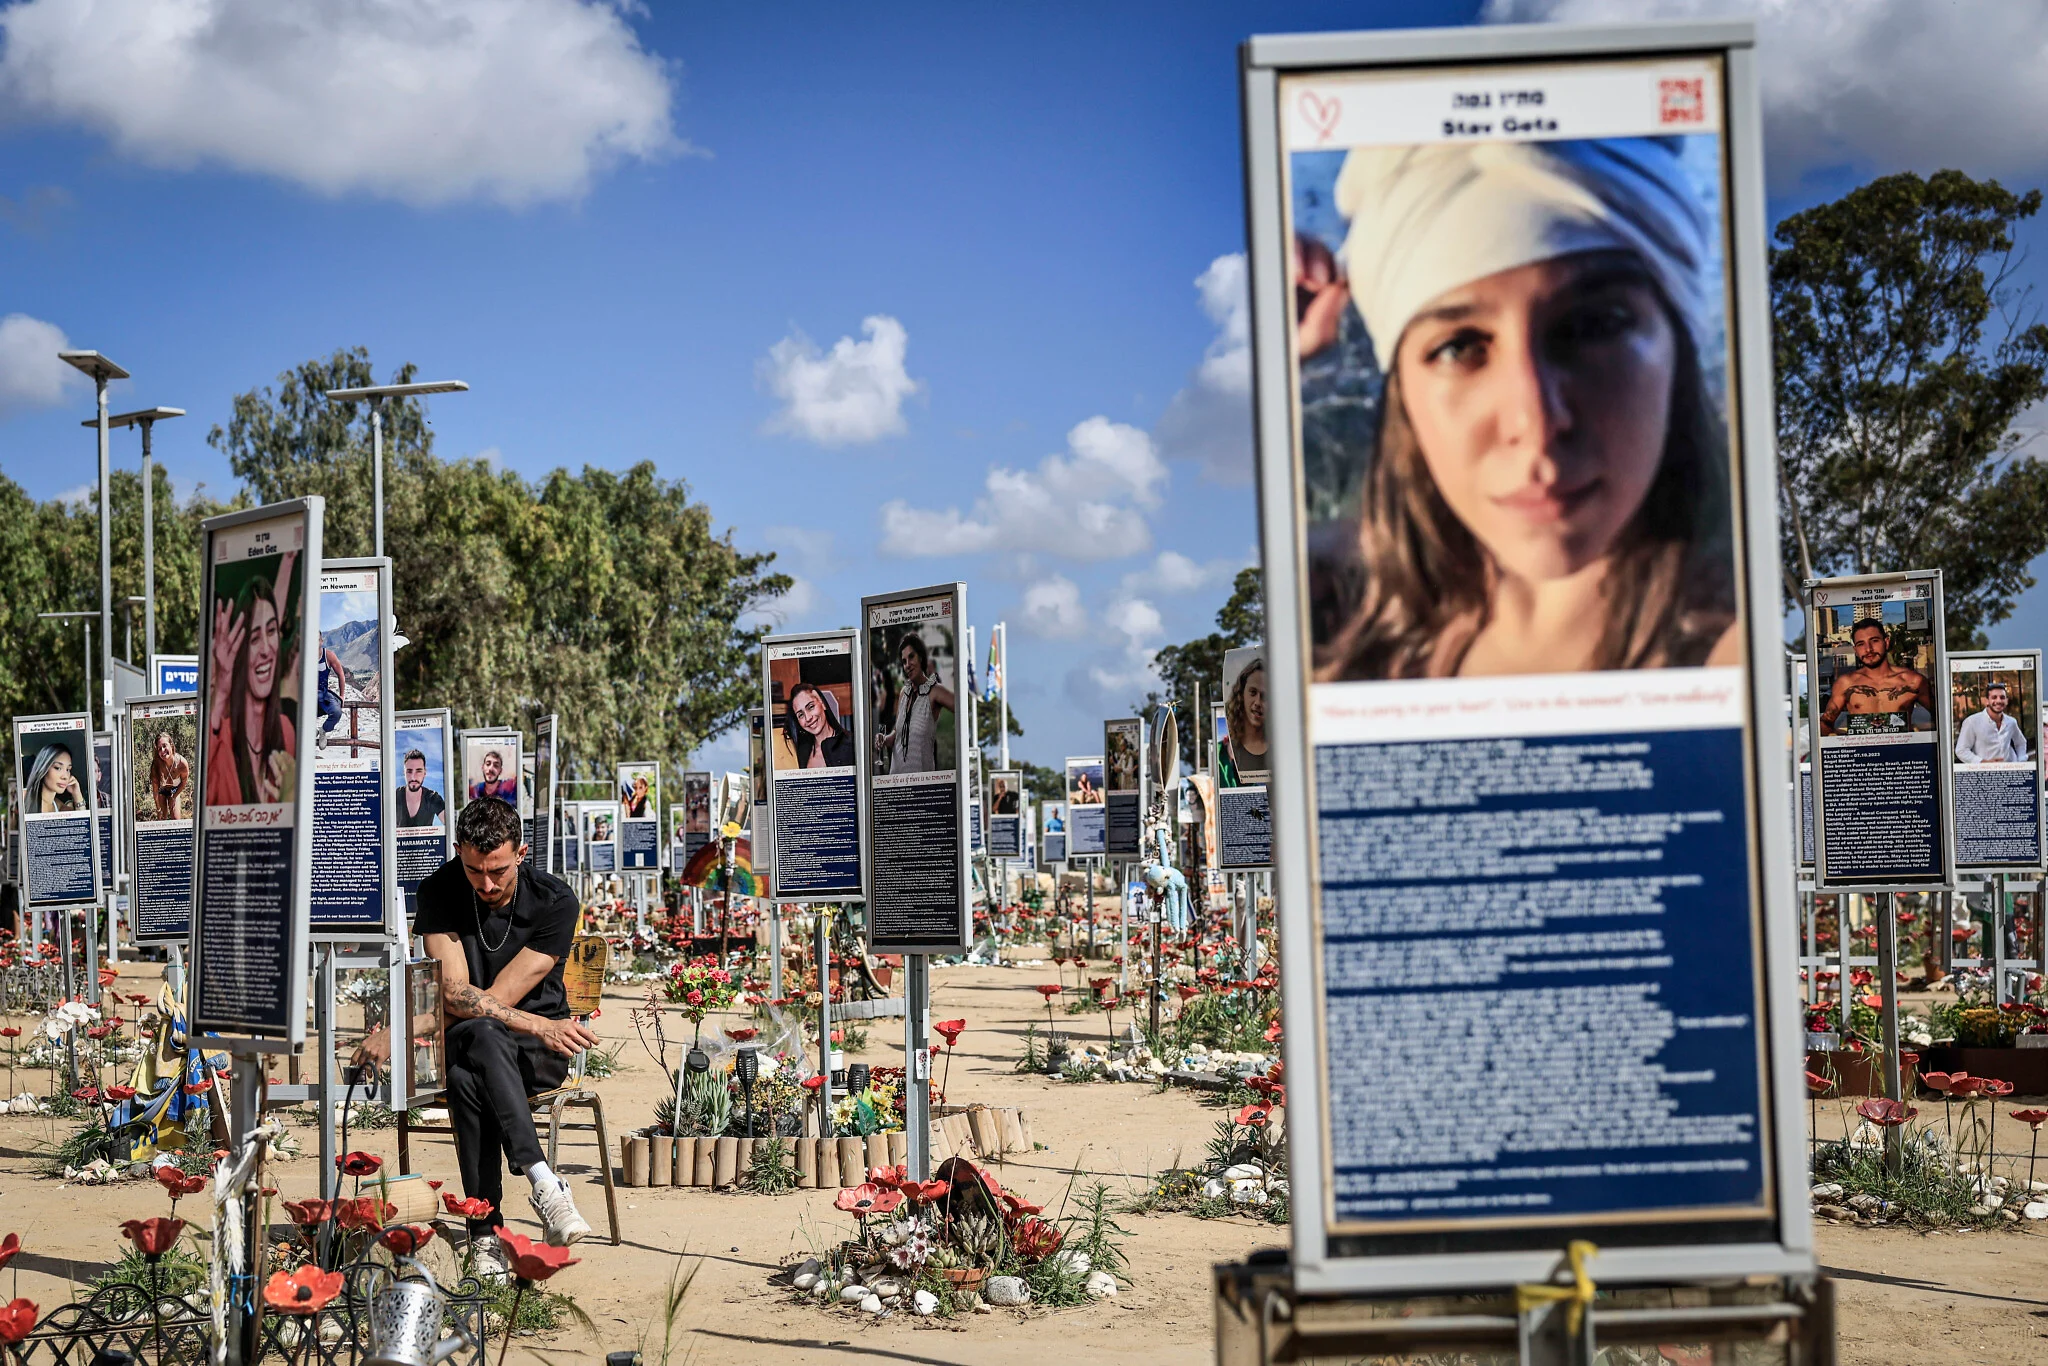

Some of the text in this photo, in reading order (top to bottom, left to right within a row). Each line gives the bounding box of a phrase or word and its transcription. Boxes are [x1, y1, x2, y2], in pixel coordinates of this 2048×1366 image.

[248, 547, 263, 557] Eden
[889, 617, 900, 625] Hagit
[331, 762, 340, 770] for
[900, 776, 904, 784] as
[905, 775, 909, 783] if
[910, 775, 920, 783] there
[921, 774, 925, 782] is
[925, 774, 931, 782] no
